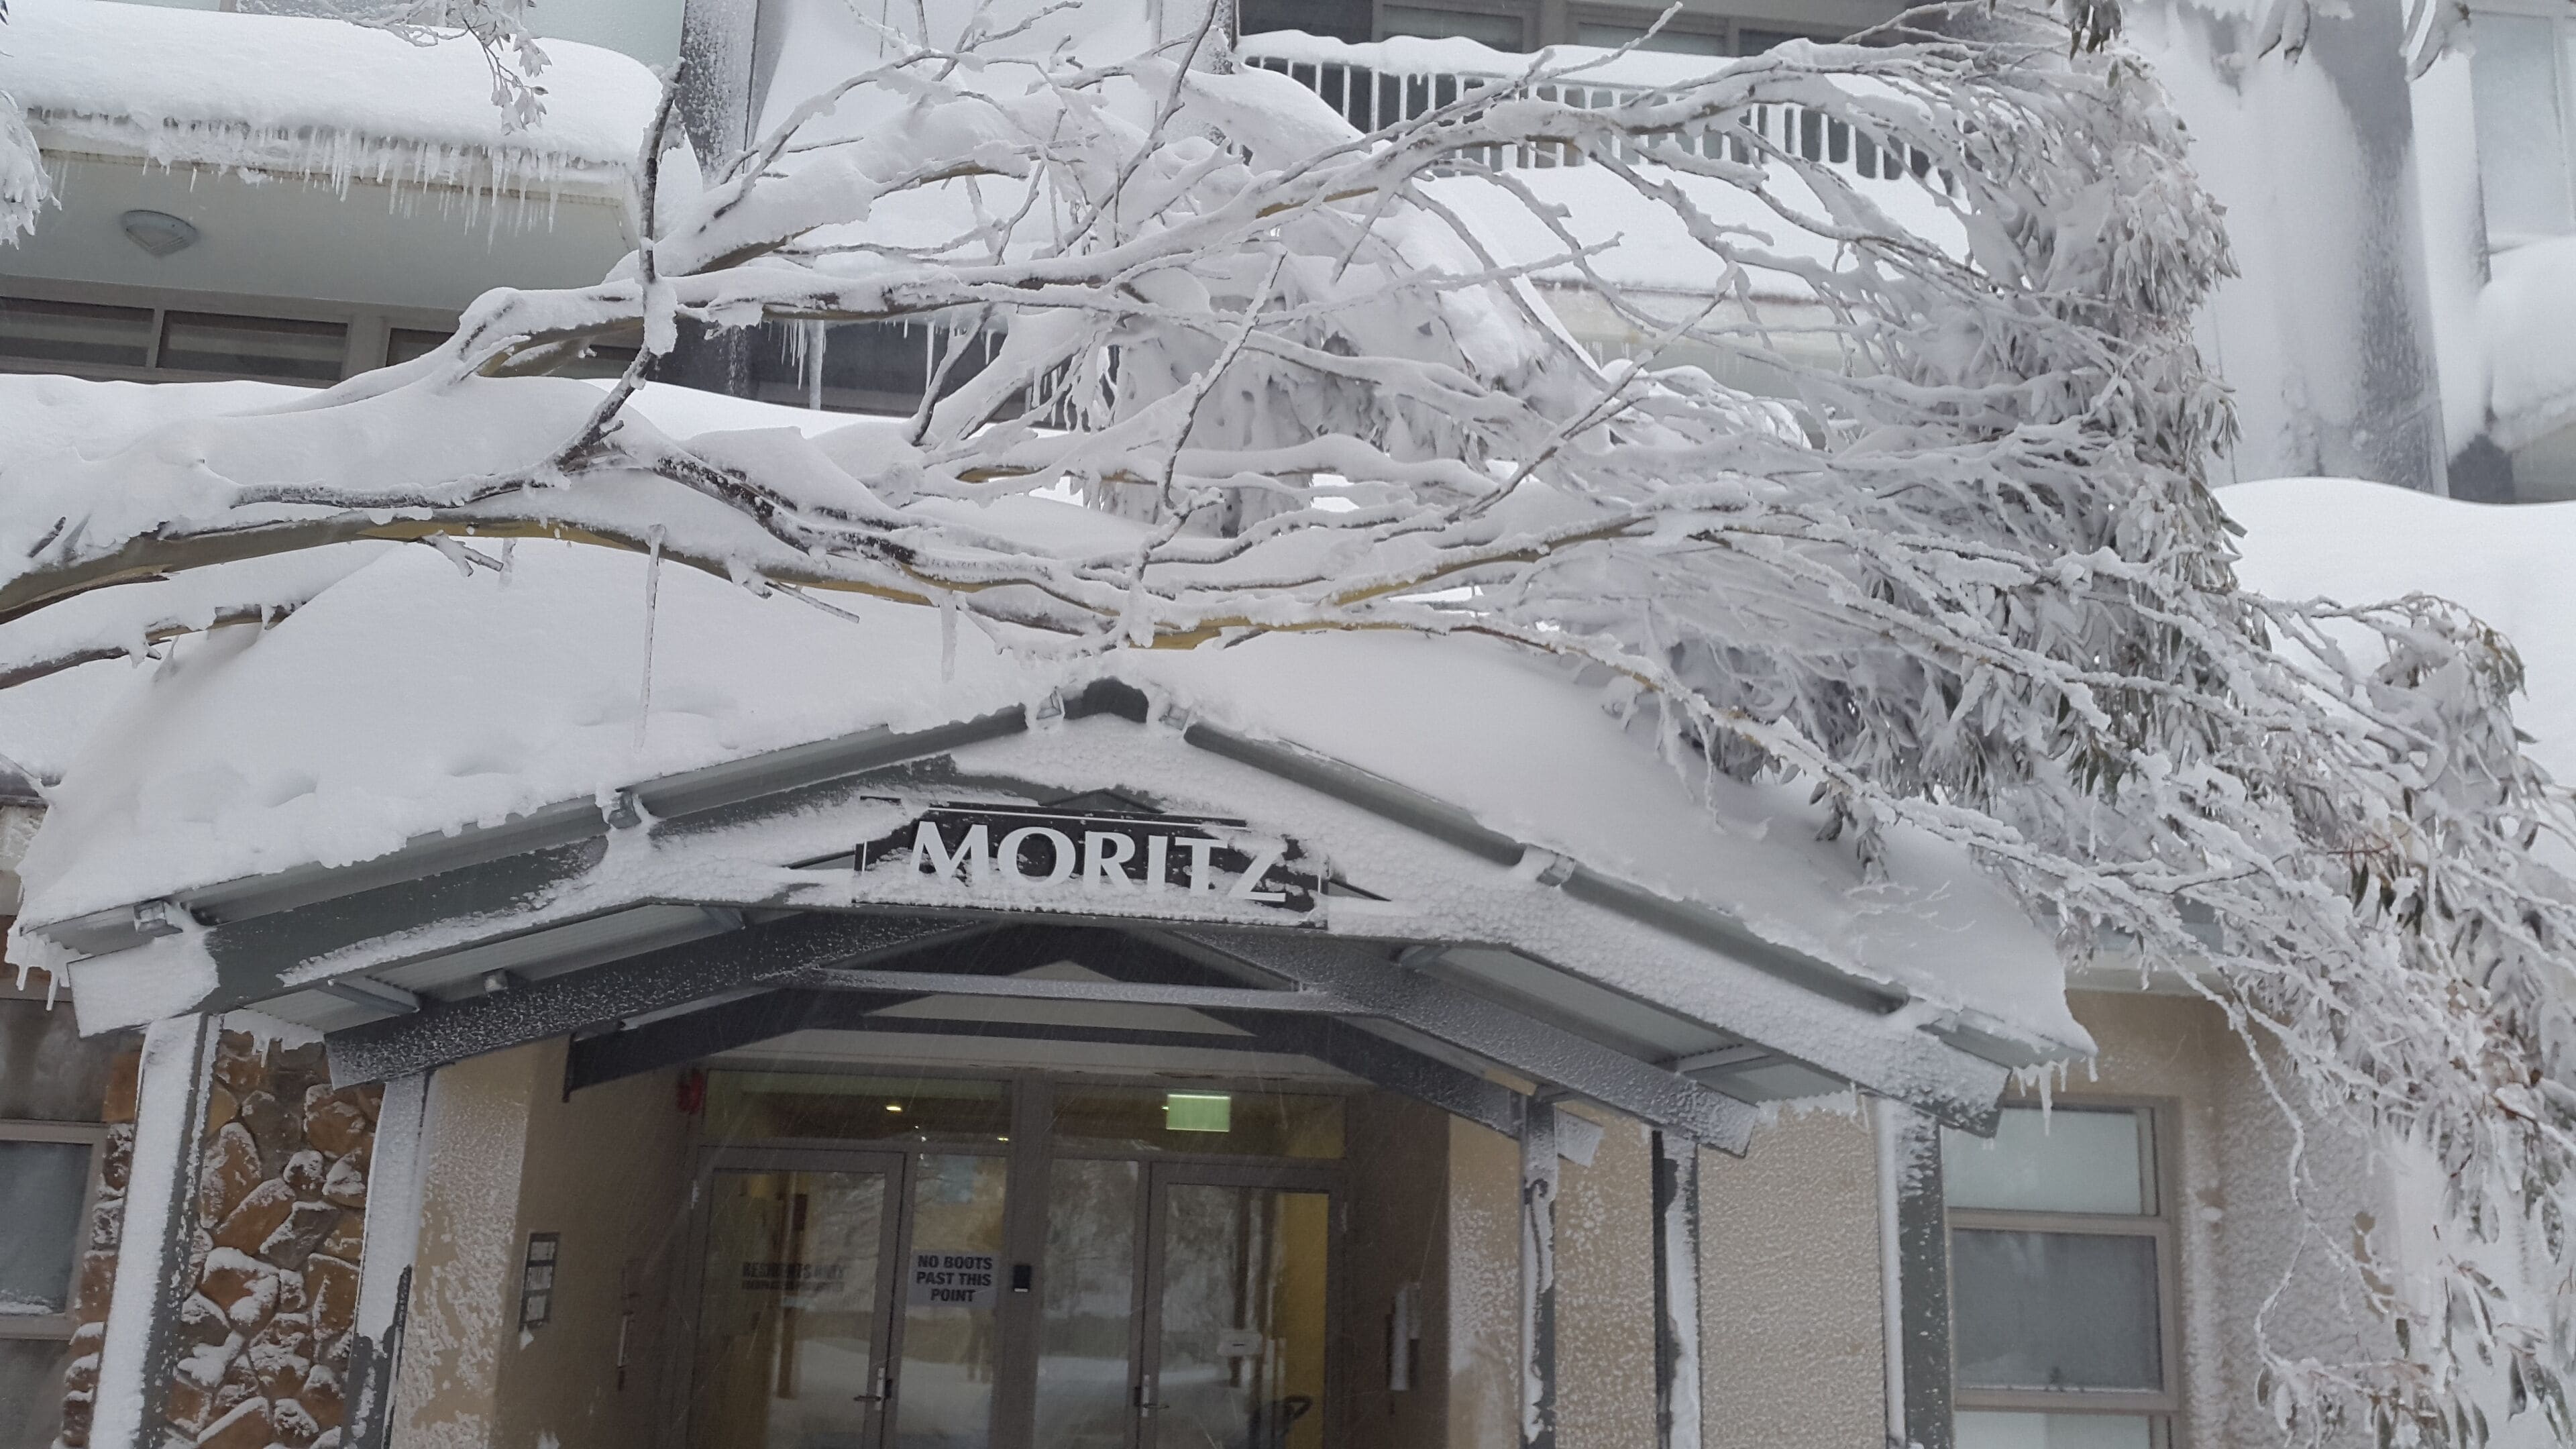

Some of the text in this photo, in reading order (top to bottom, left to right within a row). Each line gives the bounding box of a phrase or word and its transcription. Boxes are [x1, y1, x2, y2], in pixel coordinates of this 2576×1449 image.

[909, 820, 1287, 903] MORITZ
[917, 1254, 994, 1271] NO BOOTS
[916, 1271, 993, 1287] PAST THIS
[930, 1288, 976, 1302] POINT
